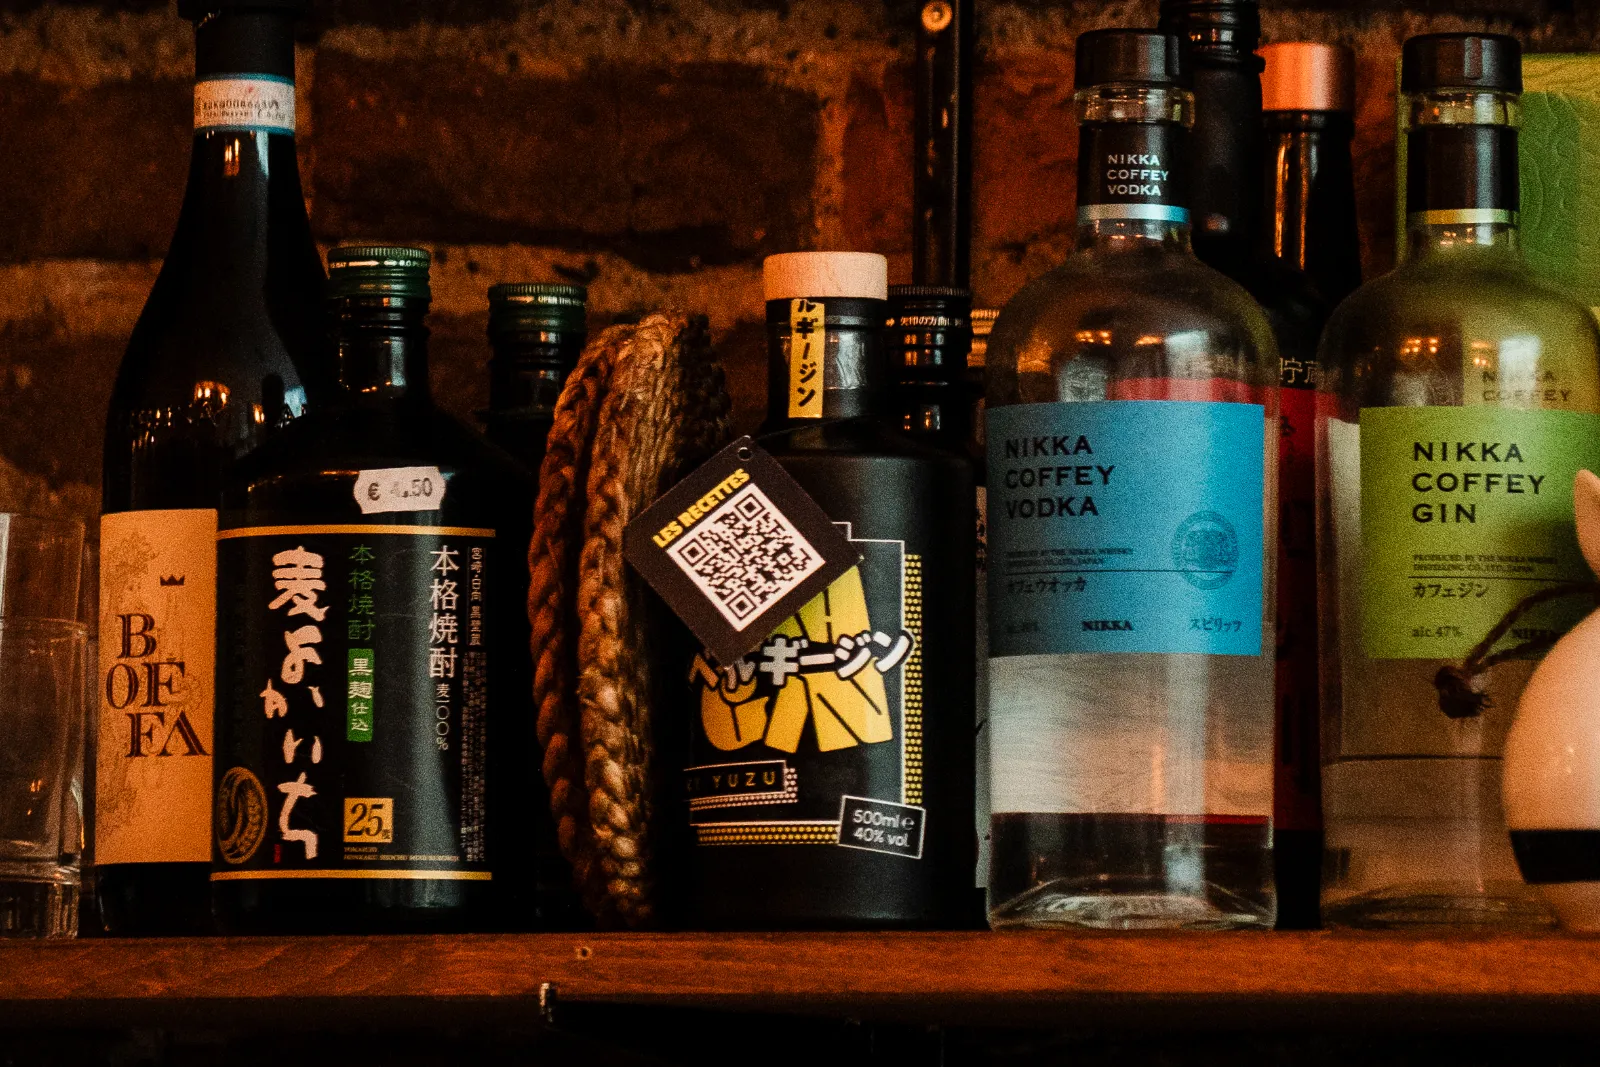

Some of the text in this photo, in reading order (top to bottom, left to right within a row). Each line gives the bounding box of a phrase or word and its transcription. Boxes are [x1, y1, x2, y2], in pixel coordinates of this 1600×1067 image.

[1107, 154, 1161, 166] NIKKA
[1106, 169, 1169, 181] COFFEY
[1107, 184, 1161, 196] VODKA
[1006, 435, 1092, 458] NIKKA
[1414, 442, 1523, 463] NIKKA
[1005, 465, 1115, 489] COFFEY
[1412, 472, 1545, 494] COFFEY
[652, 468, 751, 548] LES RECETTES
[1005, 496, 1099, 519] VODKA
[1412, 503, 1476, 524] GIN
[348, 543, 376, 641] 本格焼酎
[428, 545, 460, 679] 本格焼酎
[1082, 620, 1133, 631] NIKKA
[712, 774, 776, 787] YUZU
[854, 809, 900, 836] 500ml
[854, 827, 882, 844] 40%
